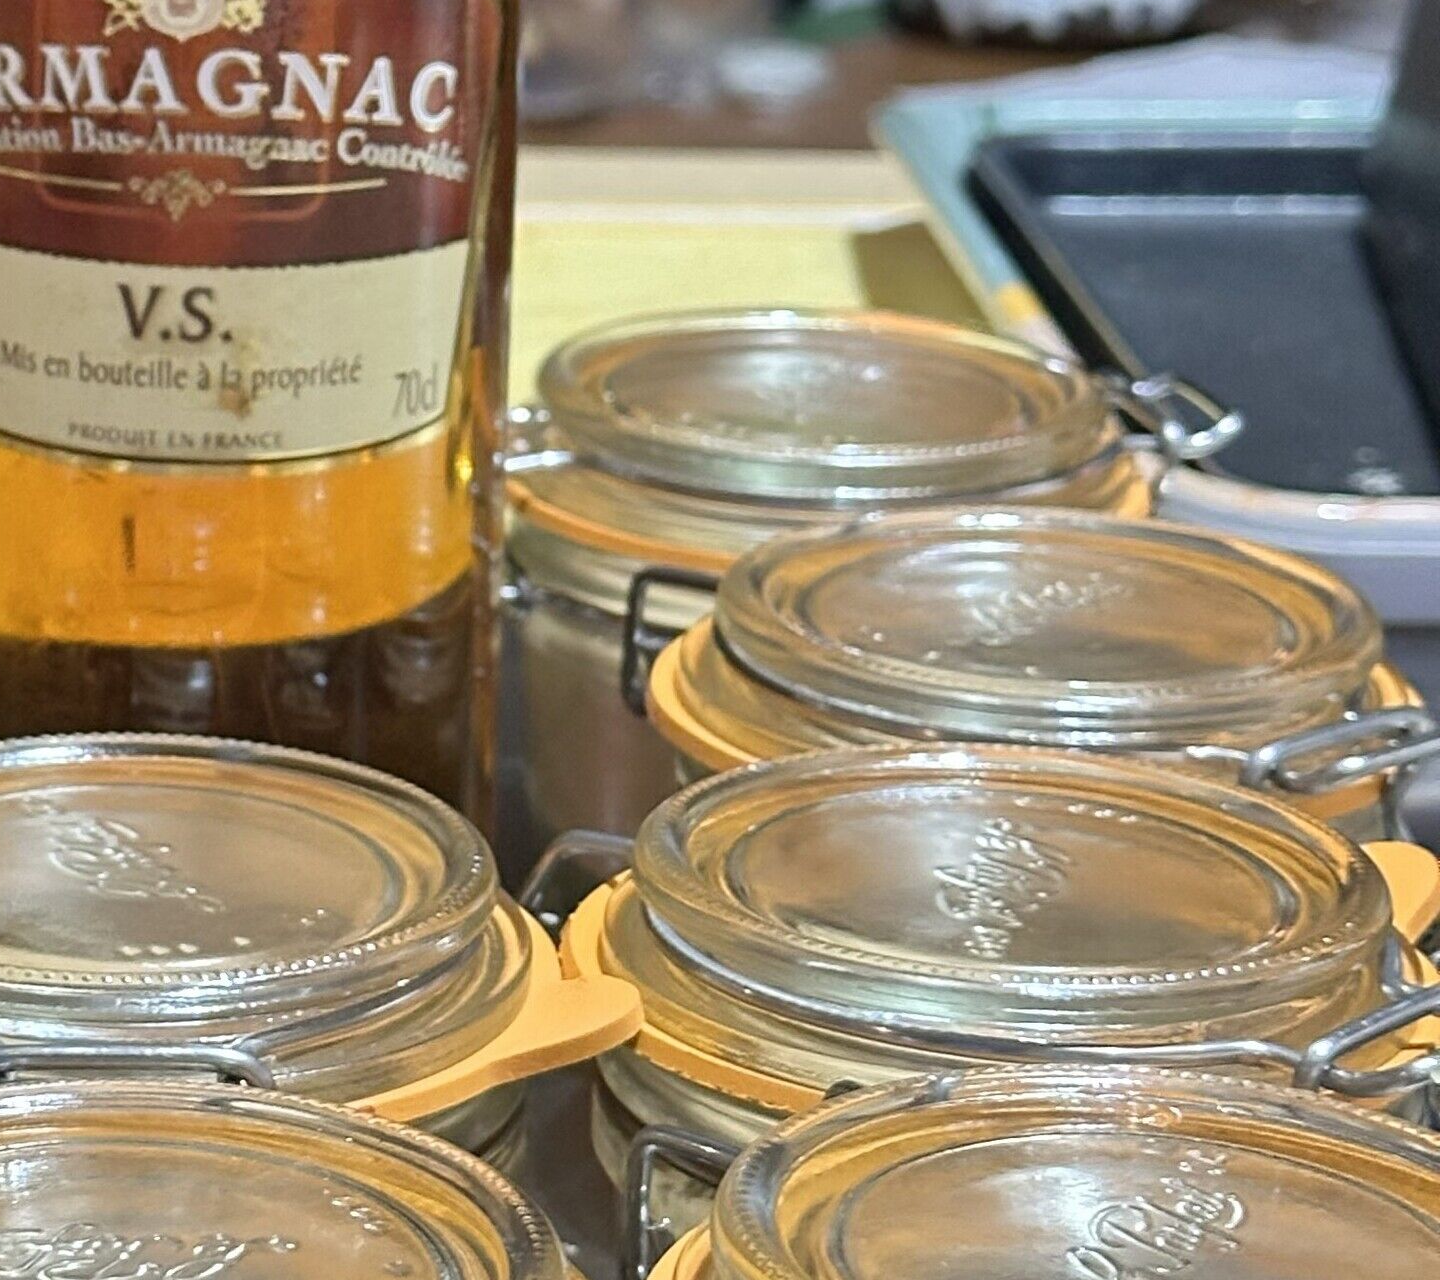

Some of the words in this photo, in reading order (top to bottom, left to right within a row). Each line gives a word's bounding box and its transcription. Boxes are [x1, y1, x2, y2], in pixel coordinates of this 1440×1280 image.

[71, 117, 328, 169] Bas-Armagnac
[117, 283, 234, 343] V.S.
[43, 354, 71, 379] en
[77, 348, 188, 392] bouteille
[195, 359, 211, 391] à
[219, 361, 243, 393] la
[250, 357, 362, 400] propriété
[392, 363, 441, 417] 70cl
[67, 422, 158, 449] PRODUIT
[166, 431, 195, 450] EN
[203, 431, 283, 451] FRANCE
